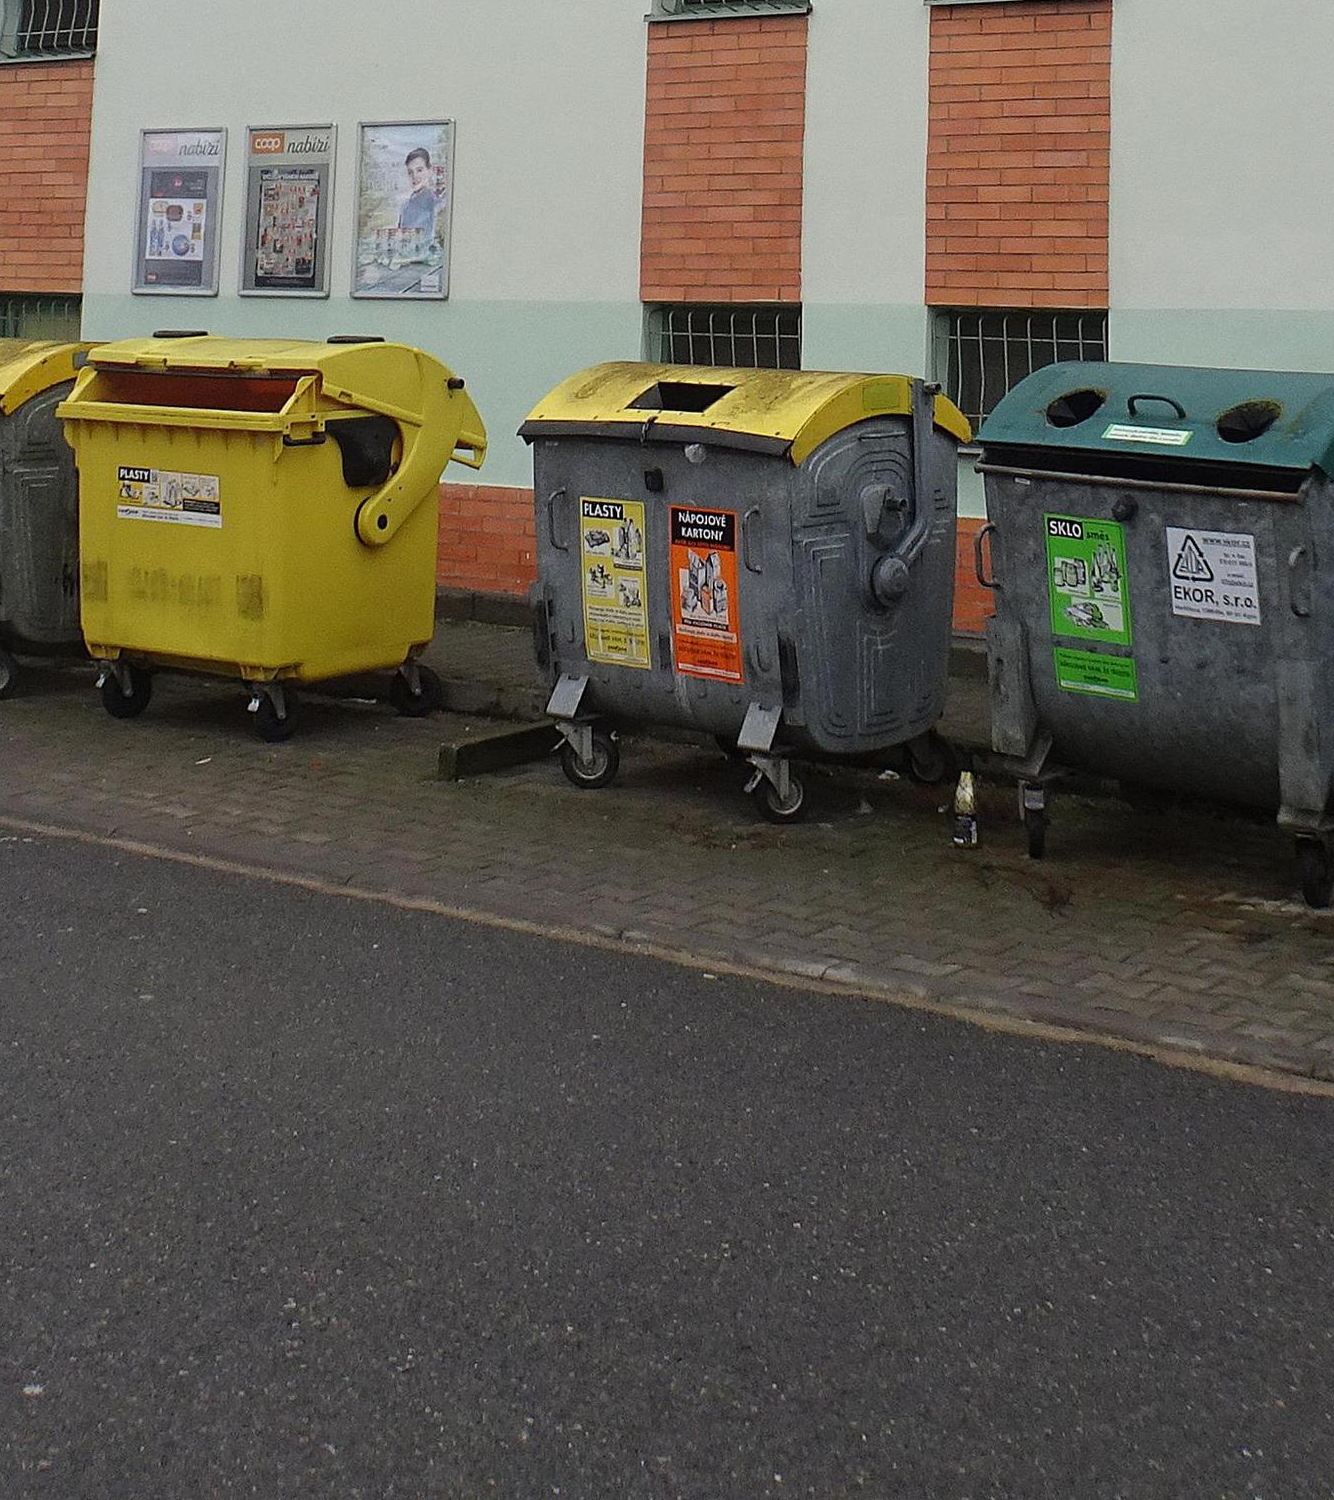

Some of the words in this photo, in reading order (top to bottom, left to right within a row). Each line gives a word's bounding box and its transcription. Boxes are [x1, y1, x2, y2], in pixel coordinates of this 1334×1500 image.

[254, 137, 281, 151] coop
[119, 469, 150, 481] PLASTY
[584, 502, 622, 519] PLASTY
[678, 511, 726, 528] NÁPOJOVÉ
[681, 526, 723, 542] KARTONY
[1049, 520, 1082, 538] SKLO
[1173, 585, 1219, 606] EKOR,
[1222, 594, 1257, 609] s.r.o.
